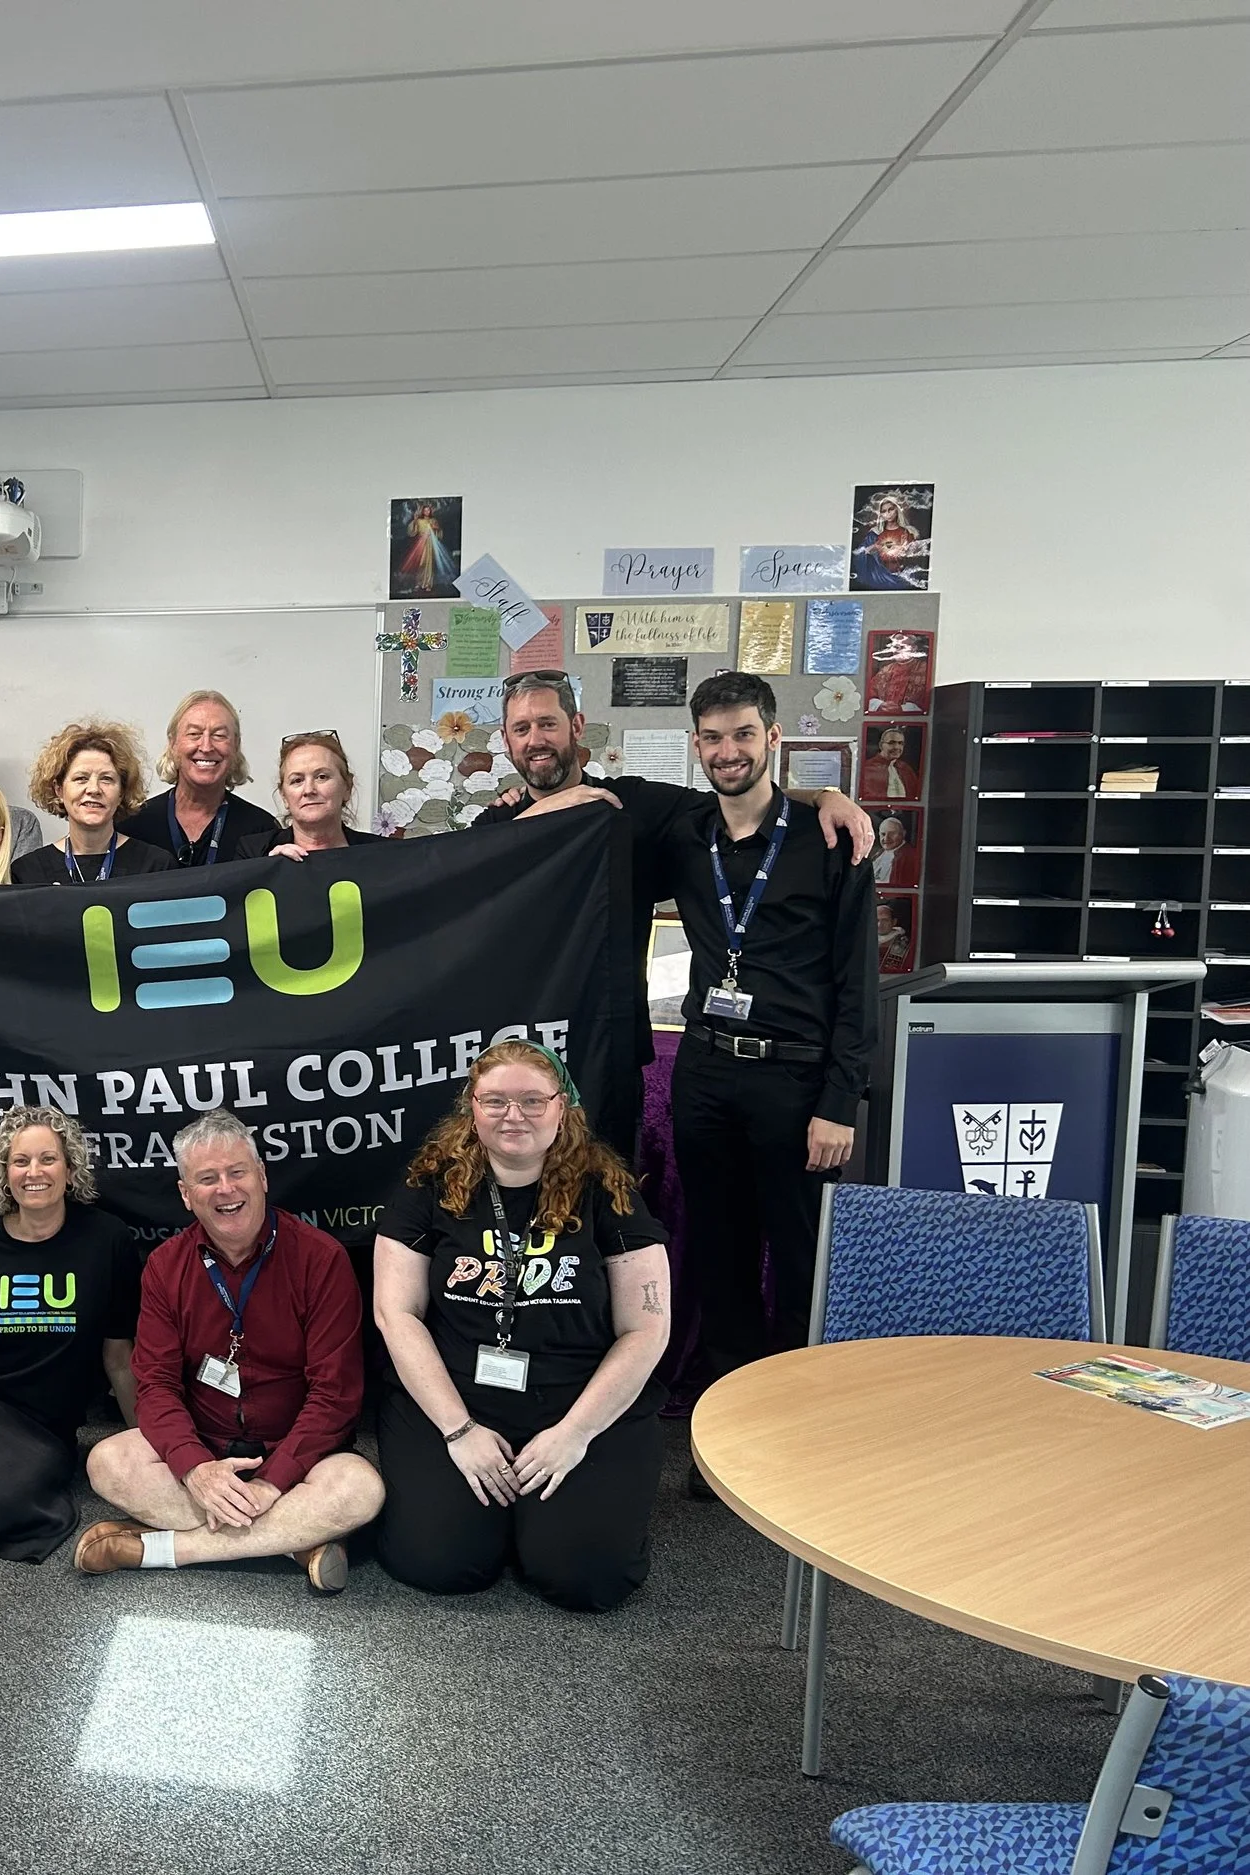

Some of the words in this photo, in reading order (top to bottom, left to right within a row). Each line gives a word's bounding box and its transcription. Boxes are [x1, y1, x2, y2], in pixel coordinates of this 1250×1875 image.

[611, 553, 706, 590] Prayer
[751, 549, 824, 589] Space
[470, 576, 531, 627] Staff
[619, 609, 656, 625] With
[660, 609, 684, 624] him
[685, 614, 696, 624] is
[615, 627, 633, 641] the
[635, 627, 680, 643] fullness
[683, 626, 697, 641] of
[697, 626, 718, 642] life
[436, 685, 485, 701] Strong
[82, 880, 364, 1013] IEU
[908, 1025, 934, 1033] Lectrum
[96, 1060, 268, 1115] PAUL
[446, 1255, 580, 1298] PRDE
[26, 1325, 38, 1333] TO
[38, 1325, 49, 1333] BE
[49, 1325, 76, 1333] UNION
